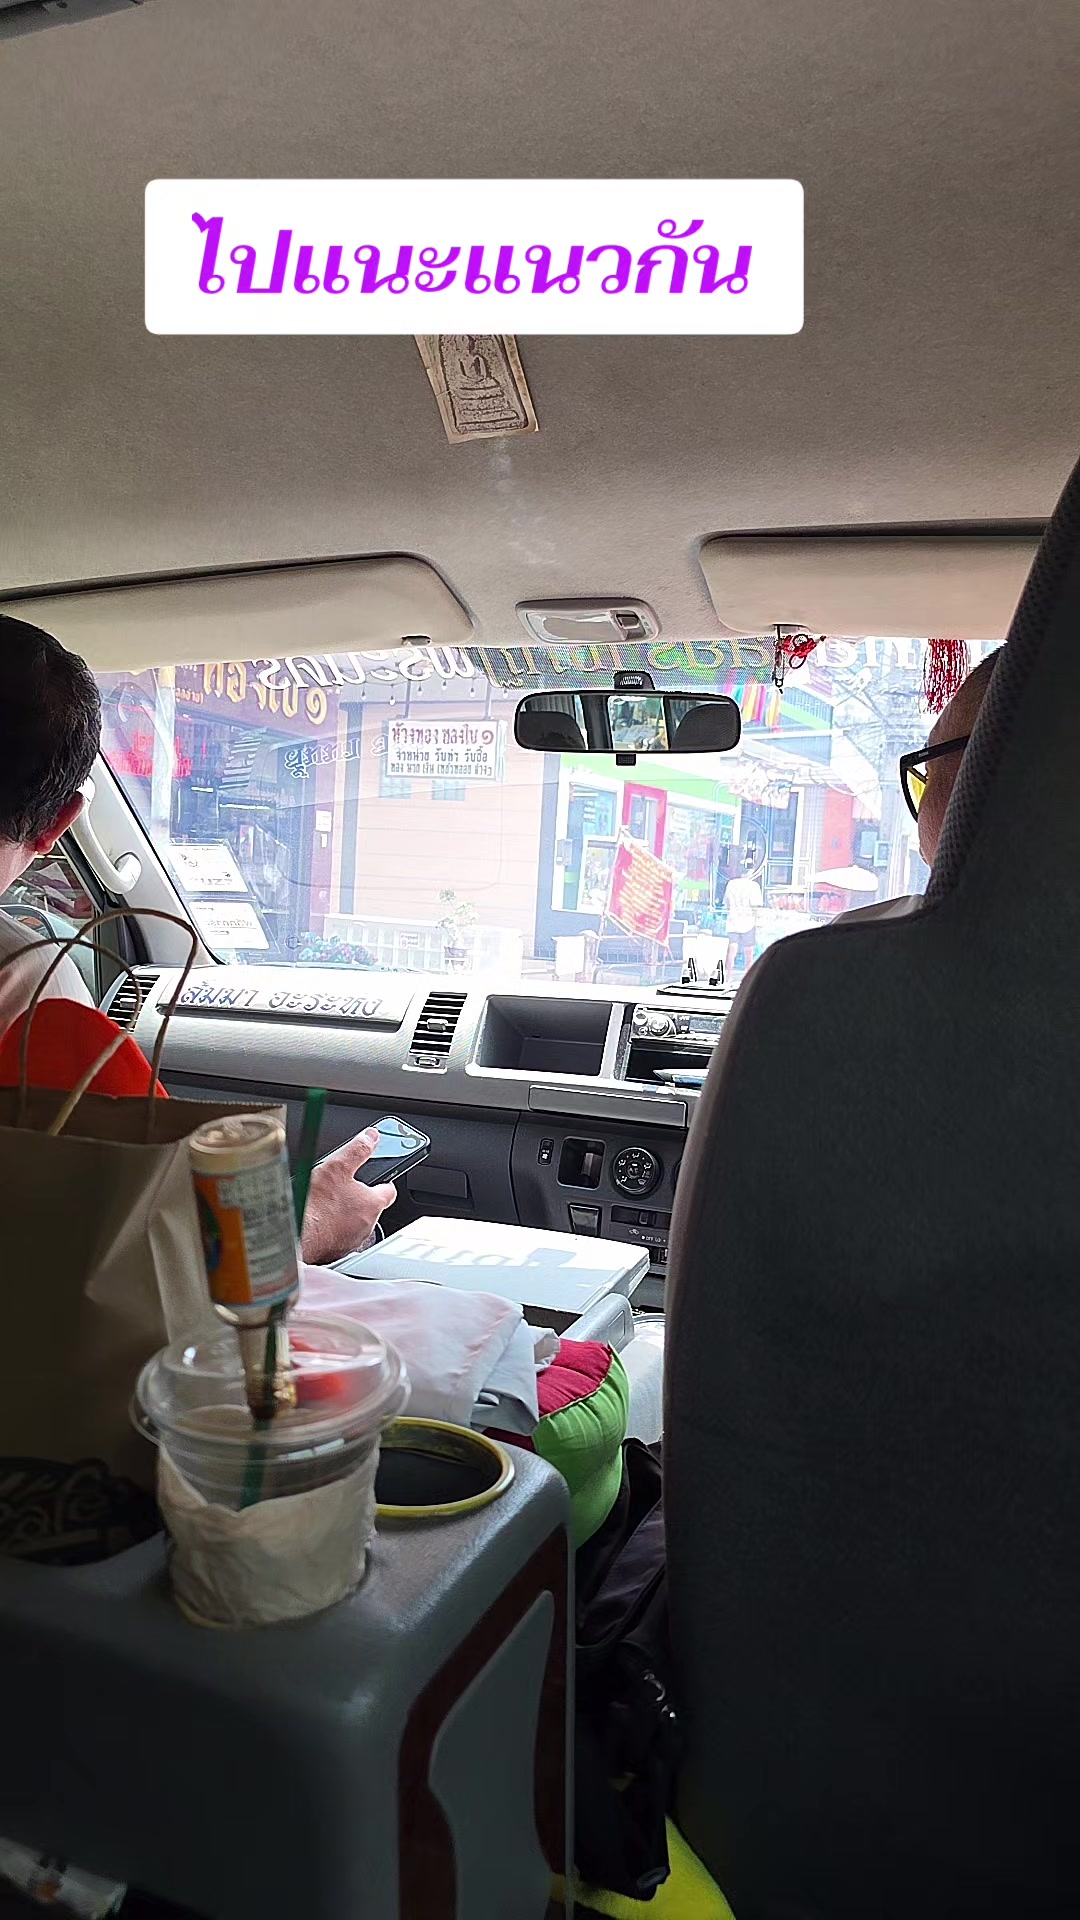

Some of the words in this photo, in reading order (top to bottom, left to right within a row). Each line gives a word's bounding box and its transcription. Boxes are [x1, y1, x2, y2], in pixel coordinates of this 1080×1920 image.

[391, 722, 439, 744] ห้างทอง
[465, 745, 488, 762] รับซื้อ
[180, 980, 259, 1008] สัมมา
[268, 990, 385, 1018] อะระหง
